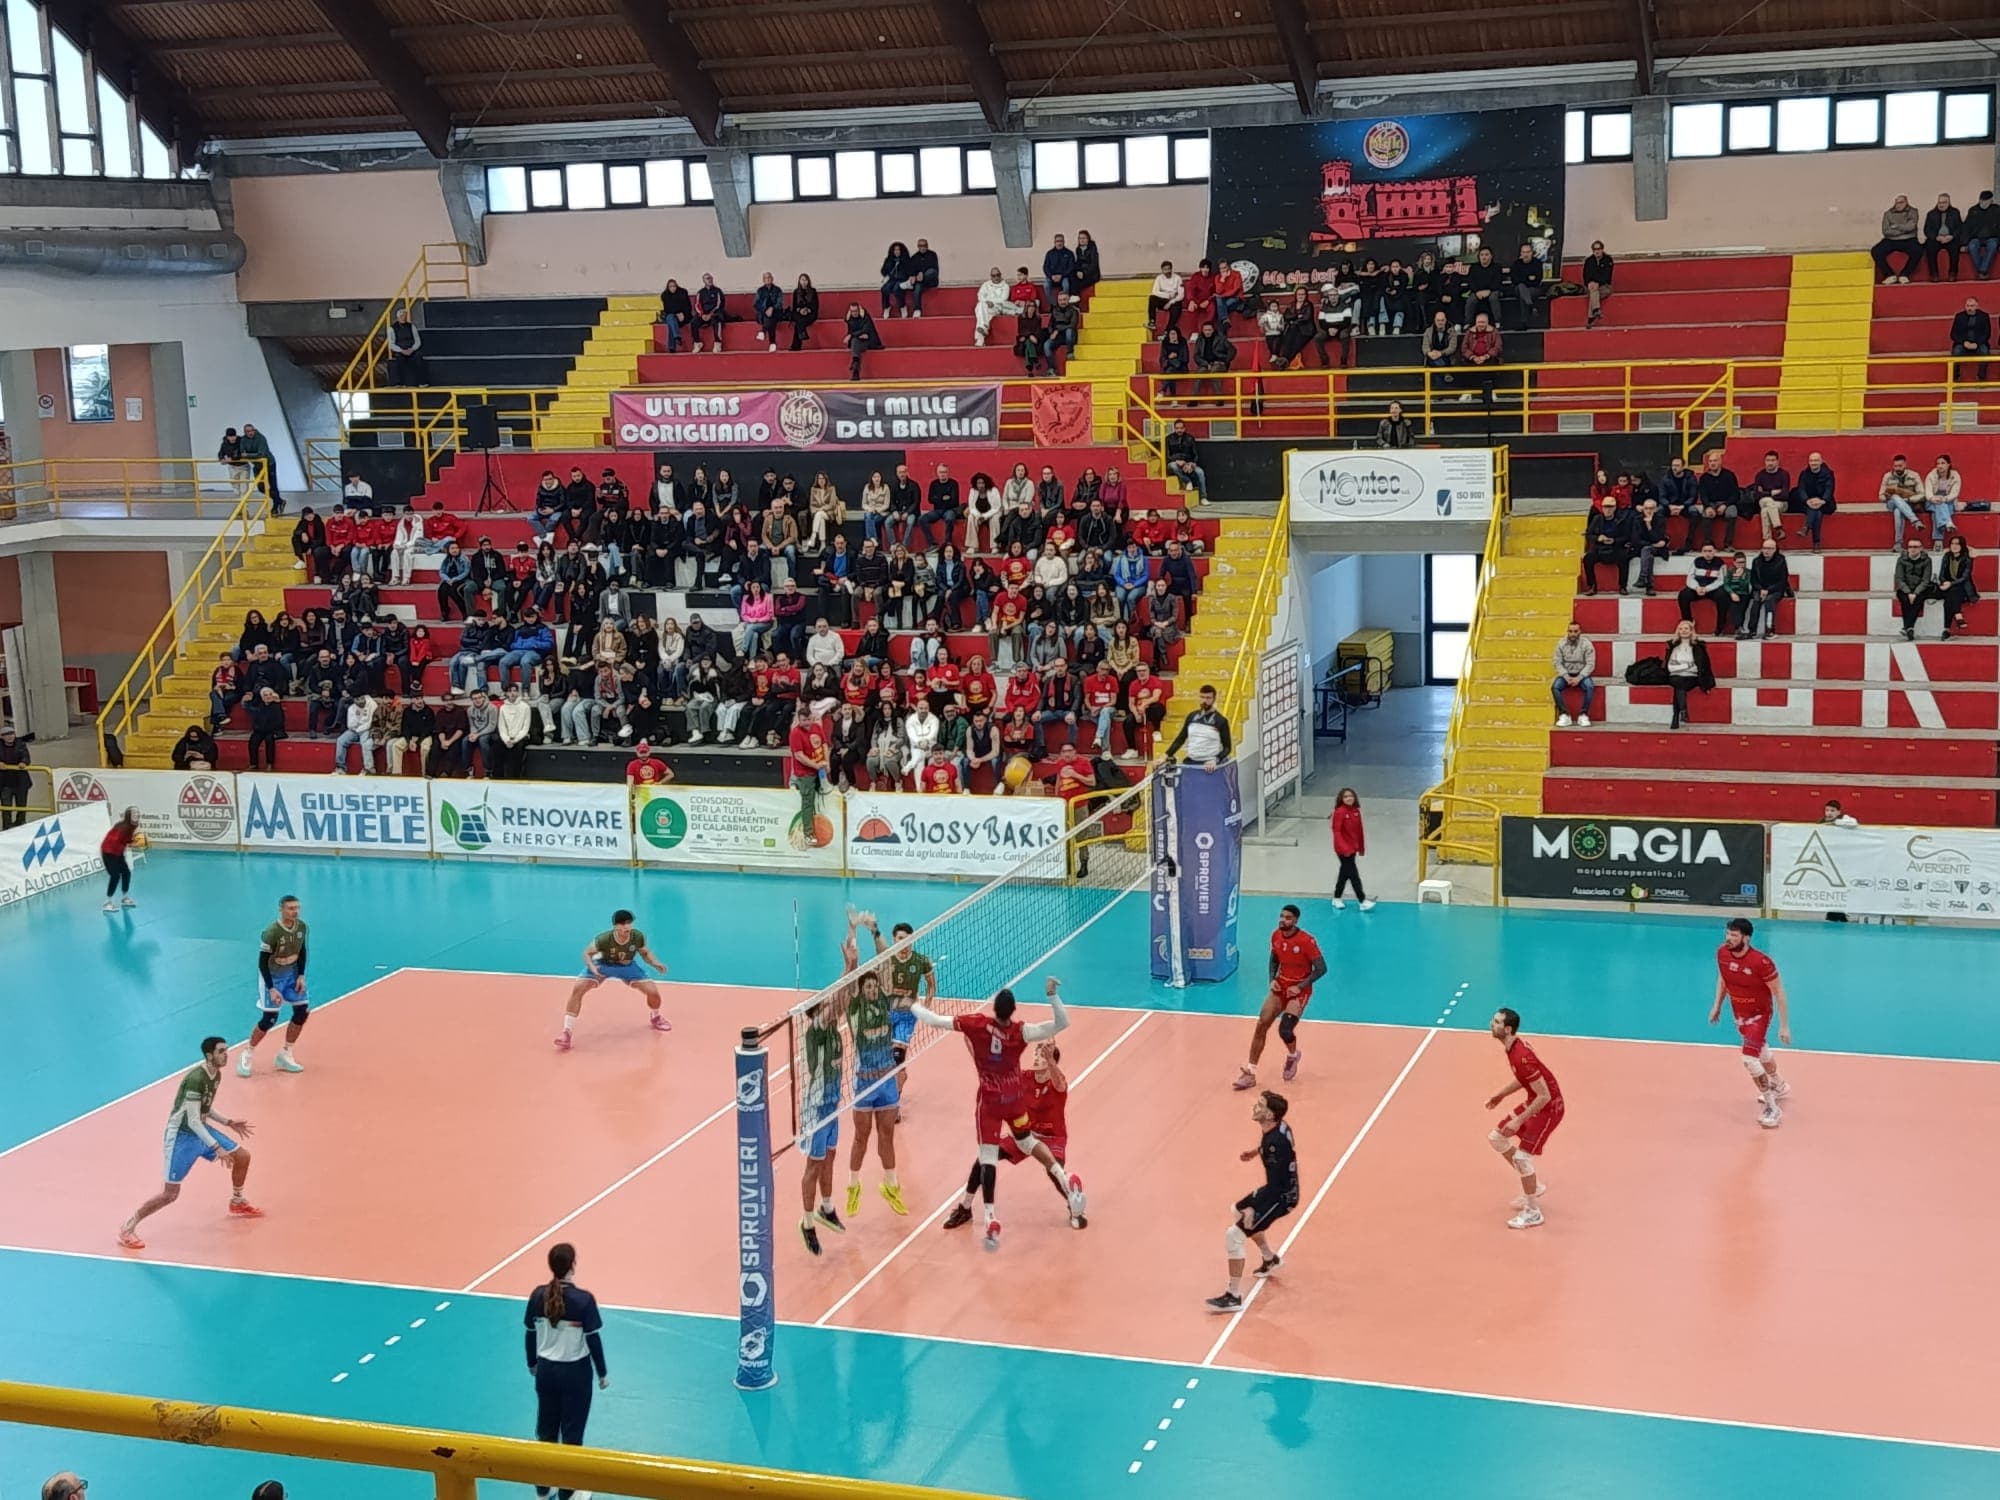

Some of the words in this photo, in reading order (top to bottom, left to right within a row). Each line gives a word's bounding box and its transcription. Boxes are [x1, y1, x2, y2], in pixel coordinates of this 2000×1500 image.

[645, 397, 741, 416] ULTRAS
[866, 397, 875, 415] I
[885, 395, 957, 415] MILLE
[621, 424, 770, 443] CORIGLIANO
[836, 419, 885, 438] DEL
[892, 416, 991, 437] BRILLIA
[1319, 469, 1400, 503] Movitec
[1456, 491, 1469, 499] ISO
[300, 793, 424, 813] GIUSEPPE
[690, 796, 744, 805] CONSORZIO
[180, 807, 231, 818] MIMOSA
[502, 807, 623, 829] RENOVARE
[691, 805, 709, 813] PER
[723, 806, 757, 815] TUTELA
[691, 814, 720, 822] DELLE
[722, 815, 779, 825] CLEMENTINE
[703, 823, 748, 832] CALABRIA
[750, 825, 766, 833] IGP
[303, 813, 426, 845] MIELE
[502, 832, 566, 847] ENERGY
[573, 835, 618, 848] FARM
[1532, 823, 1731, 865] MORGIA
[850, 846, 861, 855] Le
[862, 846, 904, 857] Clementine
[905, 847, 915, 857] da
[960, 850, 996, 863] Biologica
[1576, 867, 1686, 878] morgiacooperativa.it
[1907, 860, 1971, 874] AVERSENTE
[1199, 851, 1210, 914] SPROVIERI
[1572, 886, 1611, 896] Associato
[0, 885, 20, 904] ax
[1783, 890, 1848, 901] AVERSENTE
[740, 1137, 760, 1266] SPROVIERI
